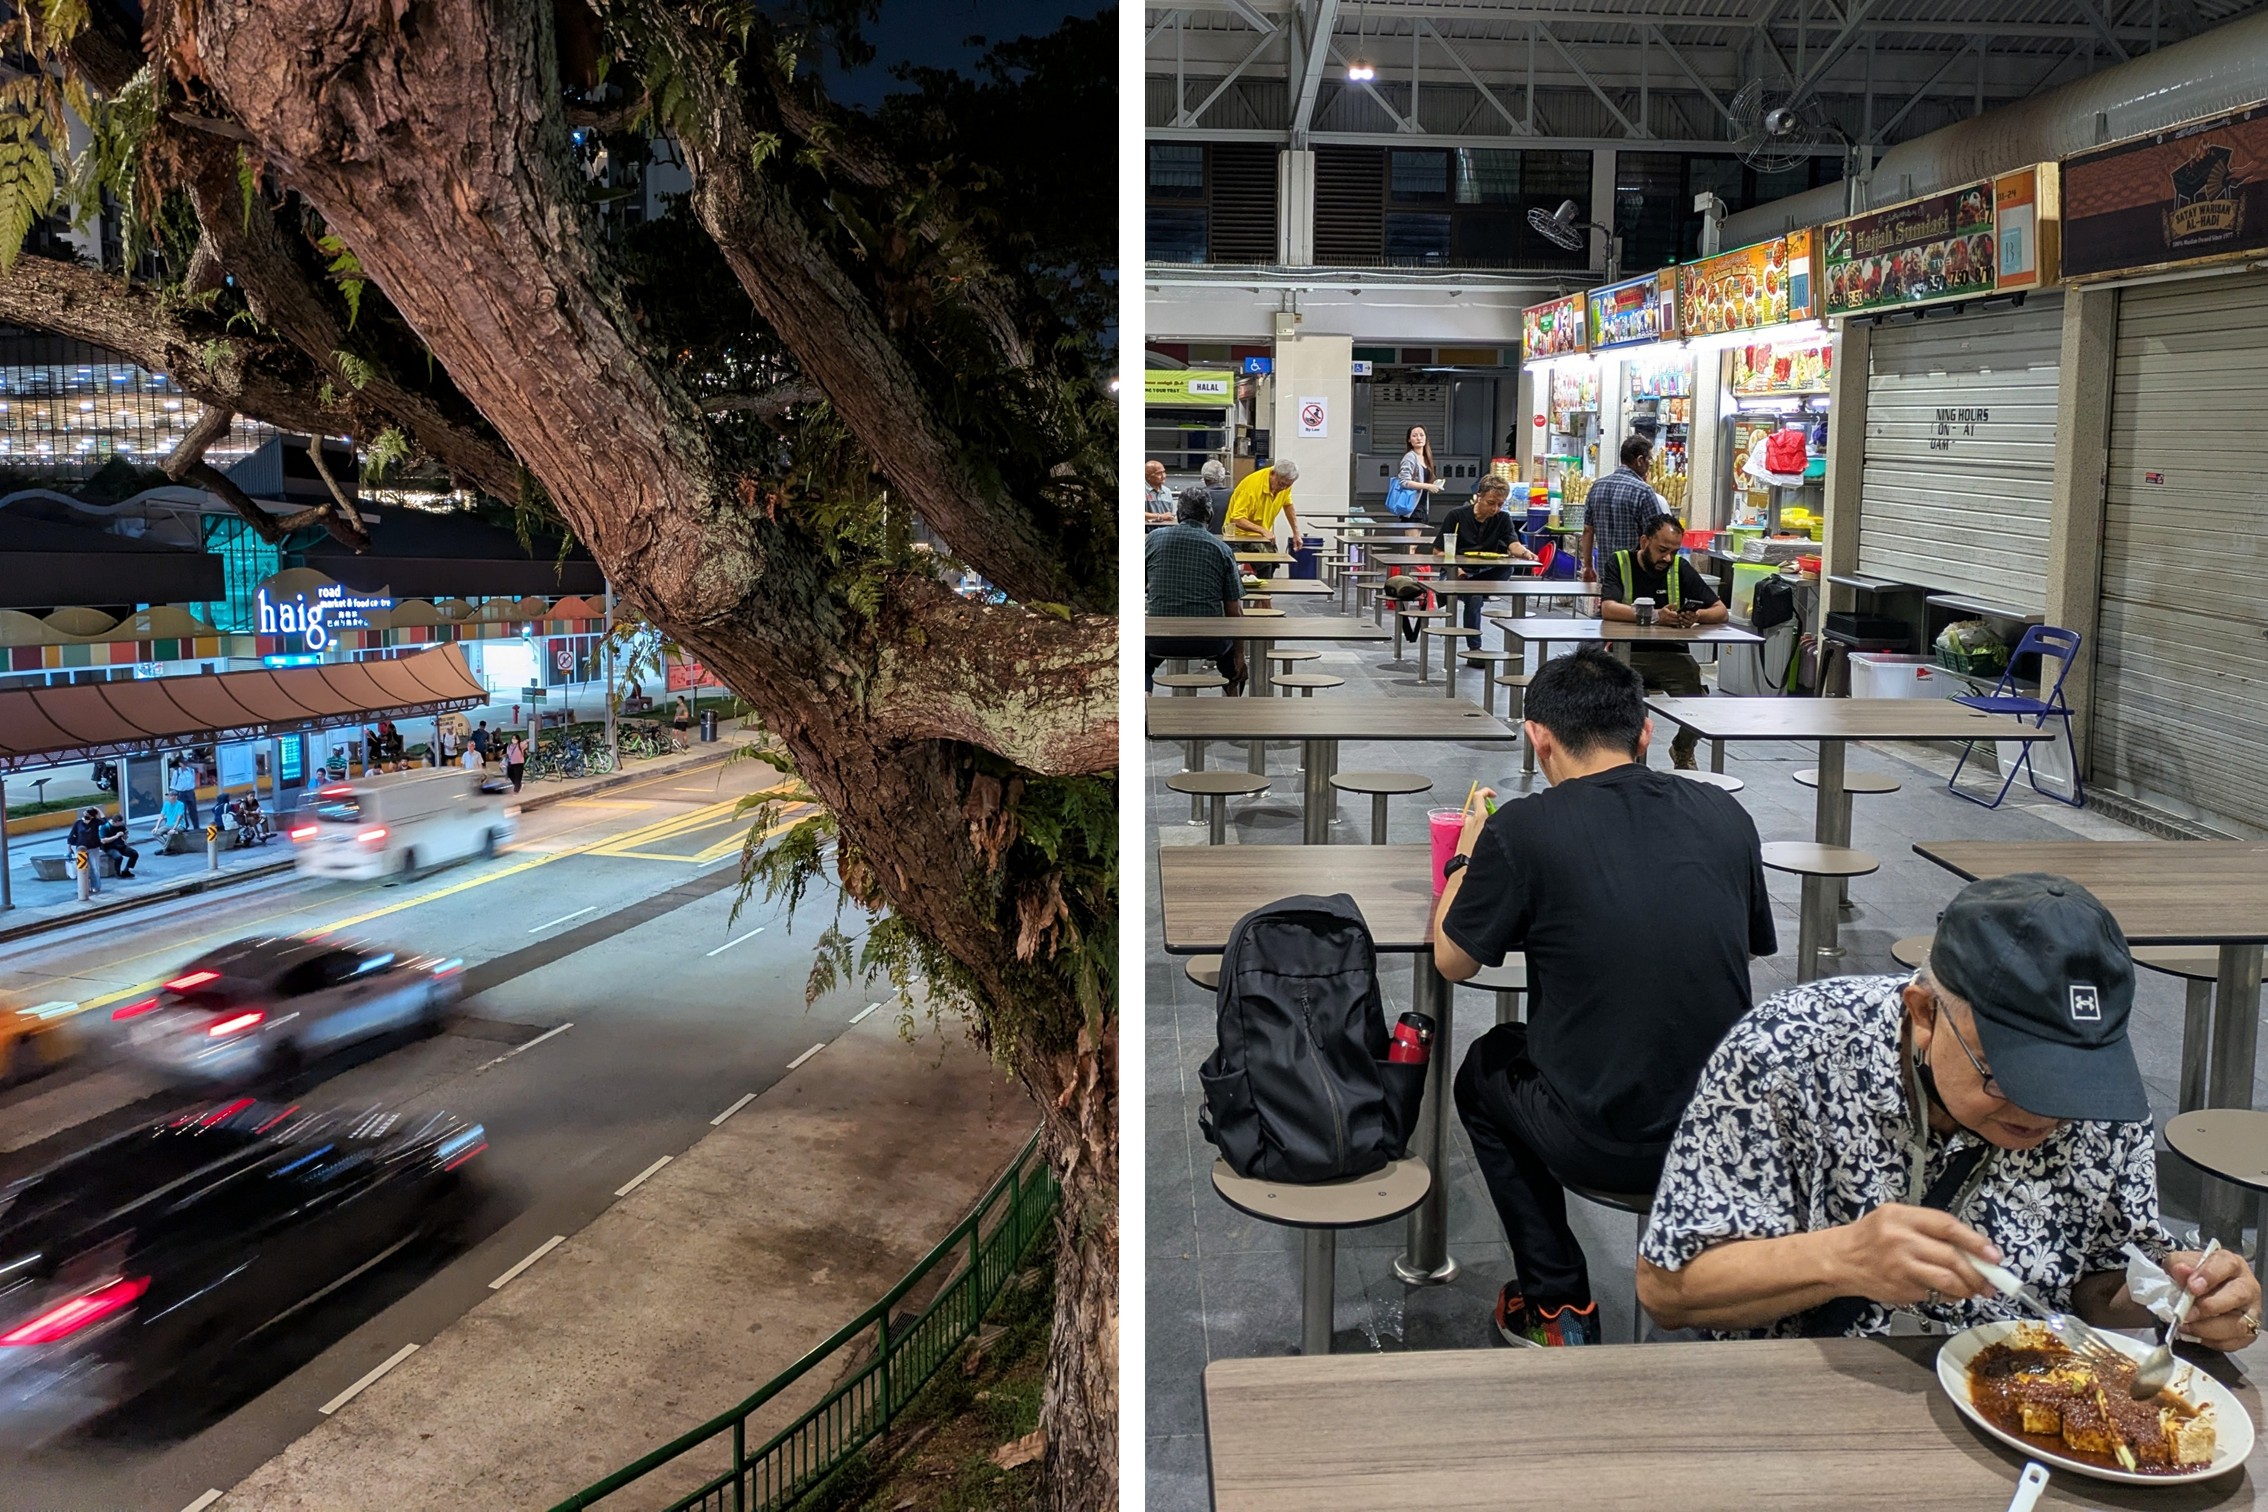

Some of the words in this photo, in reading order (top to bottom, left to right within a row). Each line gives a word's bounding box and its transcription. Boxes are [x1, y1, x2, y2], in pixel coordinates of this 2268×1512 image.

[2176, 207, 2197, 224] SATAY
[2199, 204, 2230, 215] WARISAN
[2187, 215, 2219, 230] AL-HADI
[1856, 223, 1894, 256] Hajjah
[1196, 383, 1219, 391] HALAL
[1958, 408, 1989, 421] HOURS
[318, 584, 342, 598] road
[320, 599, 346, 609] market
[347, 598, 353, 608] &
[353, 598, 369, 608] food
[258, 589, 327, 650] haig
